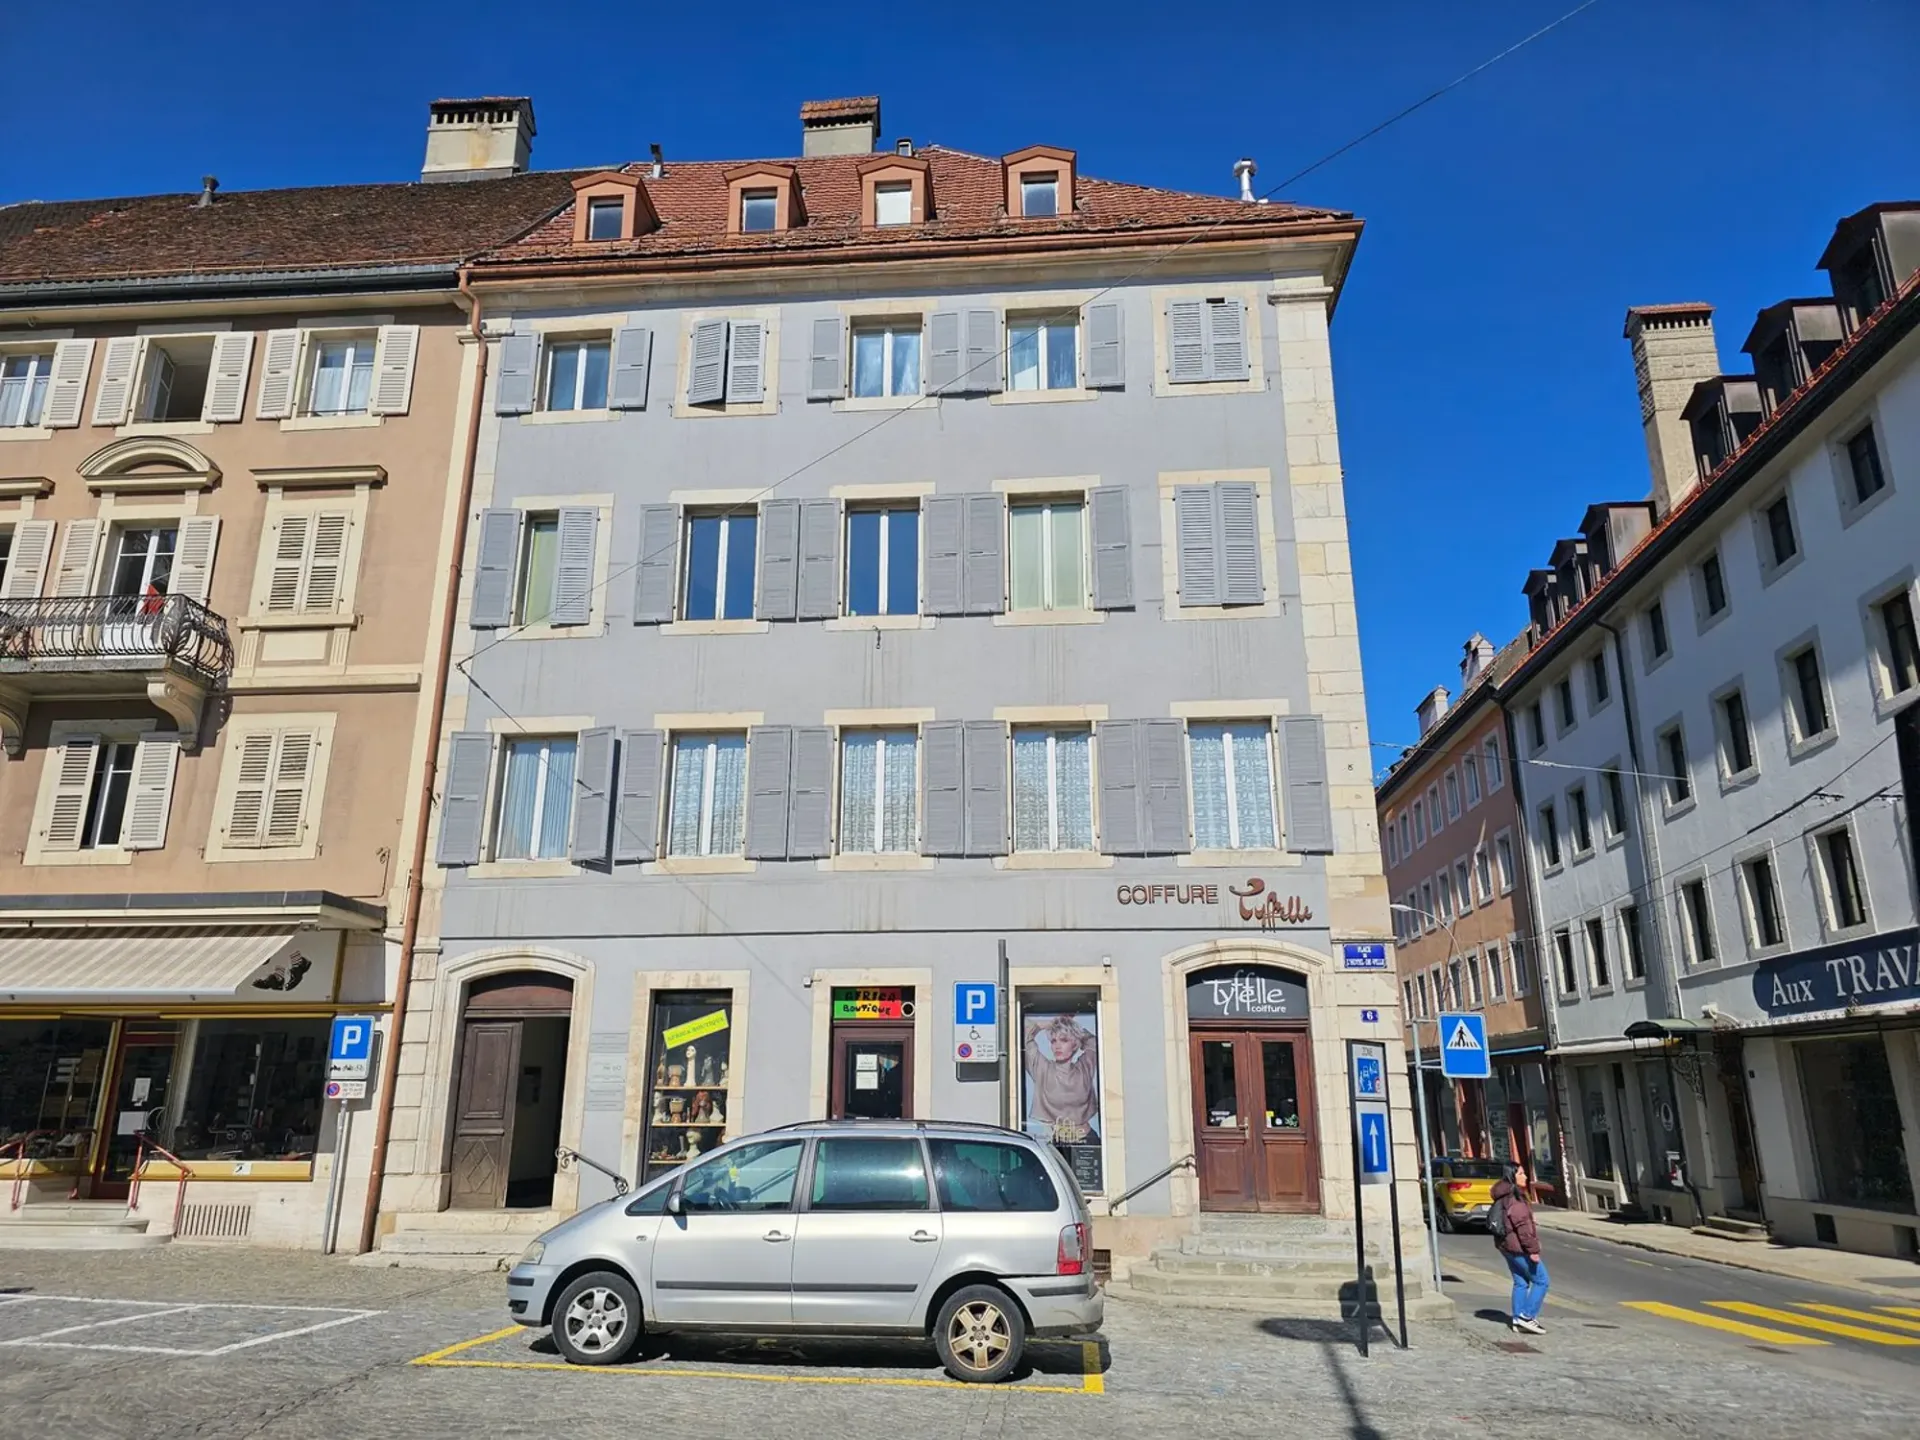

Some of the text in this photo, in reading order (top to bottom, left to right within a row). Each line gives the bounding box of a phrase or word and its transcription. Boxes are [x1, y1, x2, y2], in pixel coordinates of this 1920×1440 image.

[1117, 885, 1219, 905] COIFFURE
[1771, 943, 1920, 1006] Aux TRAV
[845, 991, 896, 1002] AFRICA
[966, 989, 986, 1020] P
[1203, 969, 1286, 1015] Tyffelle
[1251, 1005, 1287, 1013] coiffure
[1366, 1010, 1374, 1020] 6
[341, 1025, 361, 1056] P
